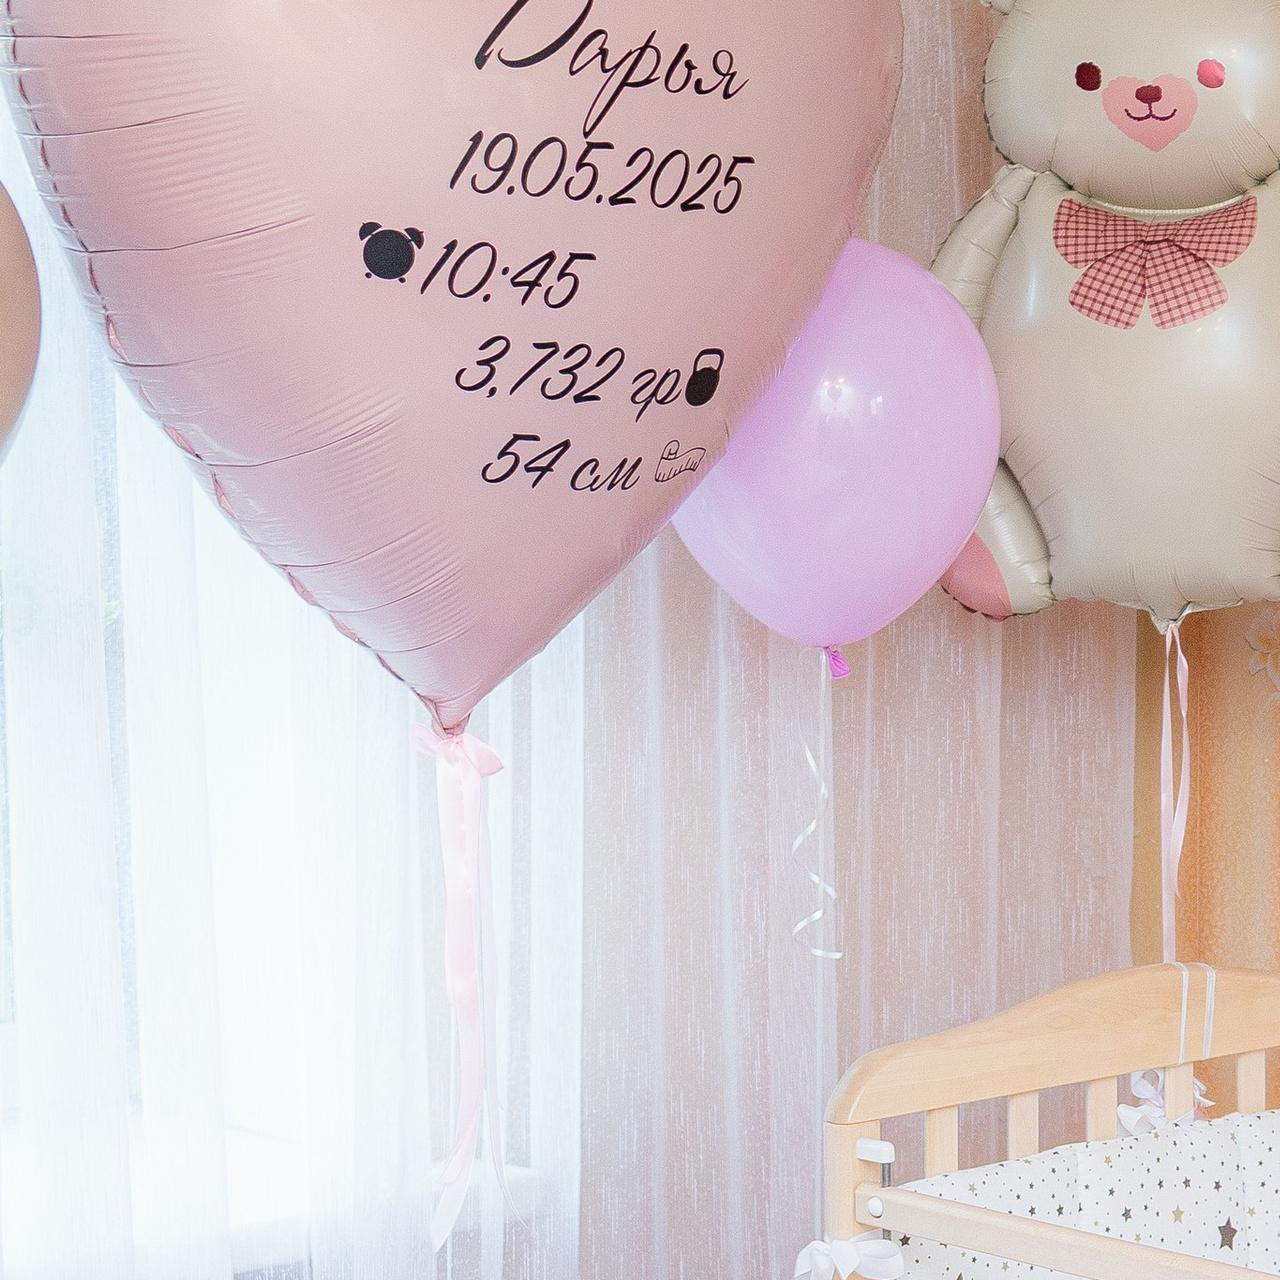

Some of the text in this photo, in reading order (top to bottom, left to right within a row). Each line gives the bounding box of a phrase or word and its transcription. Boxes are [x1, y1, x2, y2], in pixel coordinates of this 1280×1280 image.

[449, 130, 756, 215] 19.05.2025
[420, 238, 597, 309] 10:45
[454, 335, 683, 423] 3,732 гр
[481, 433, 643, 492] 54 см
